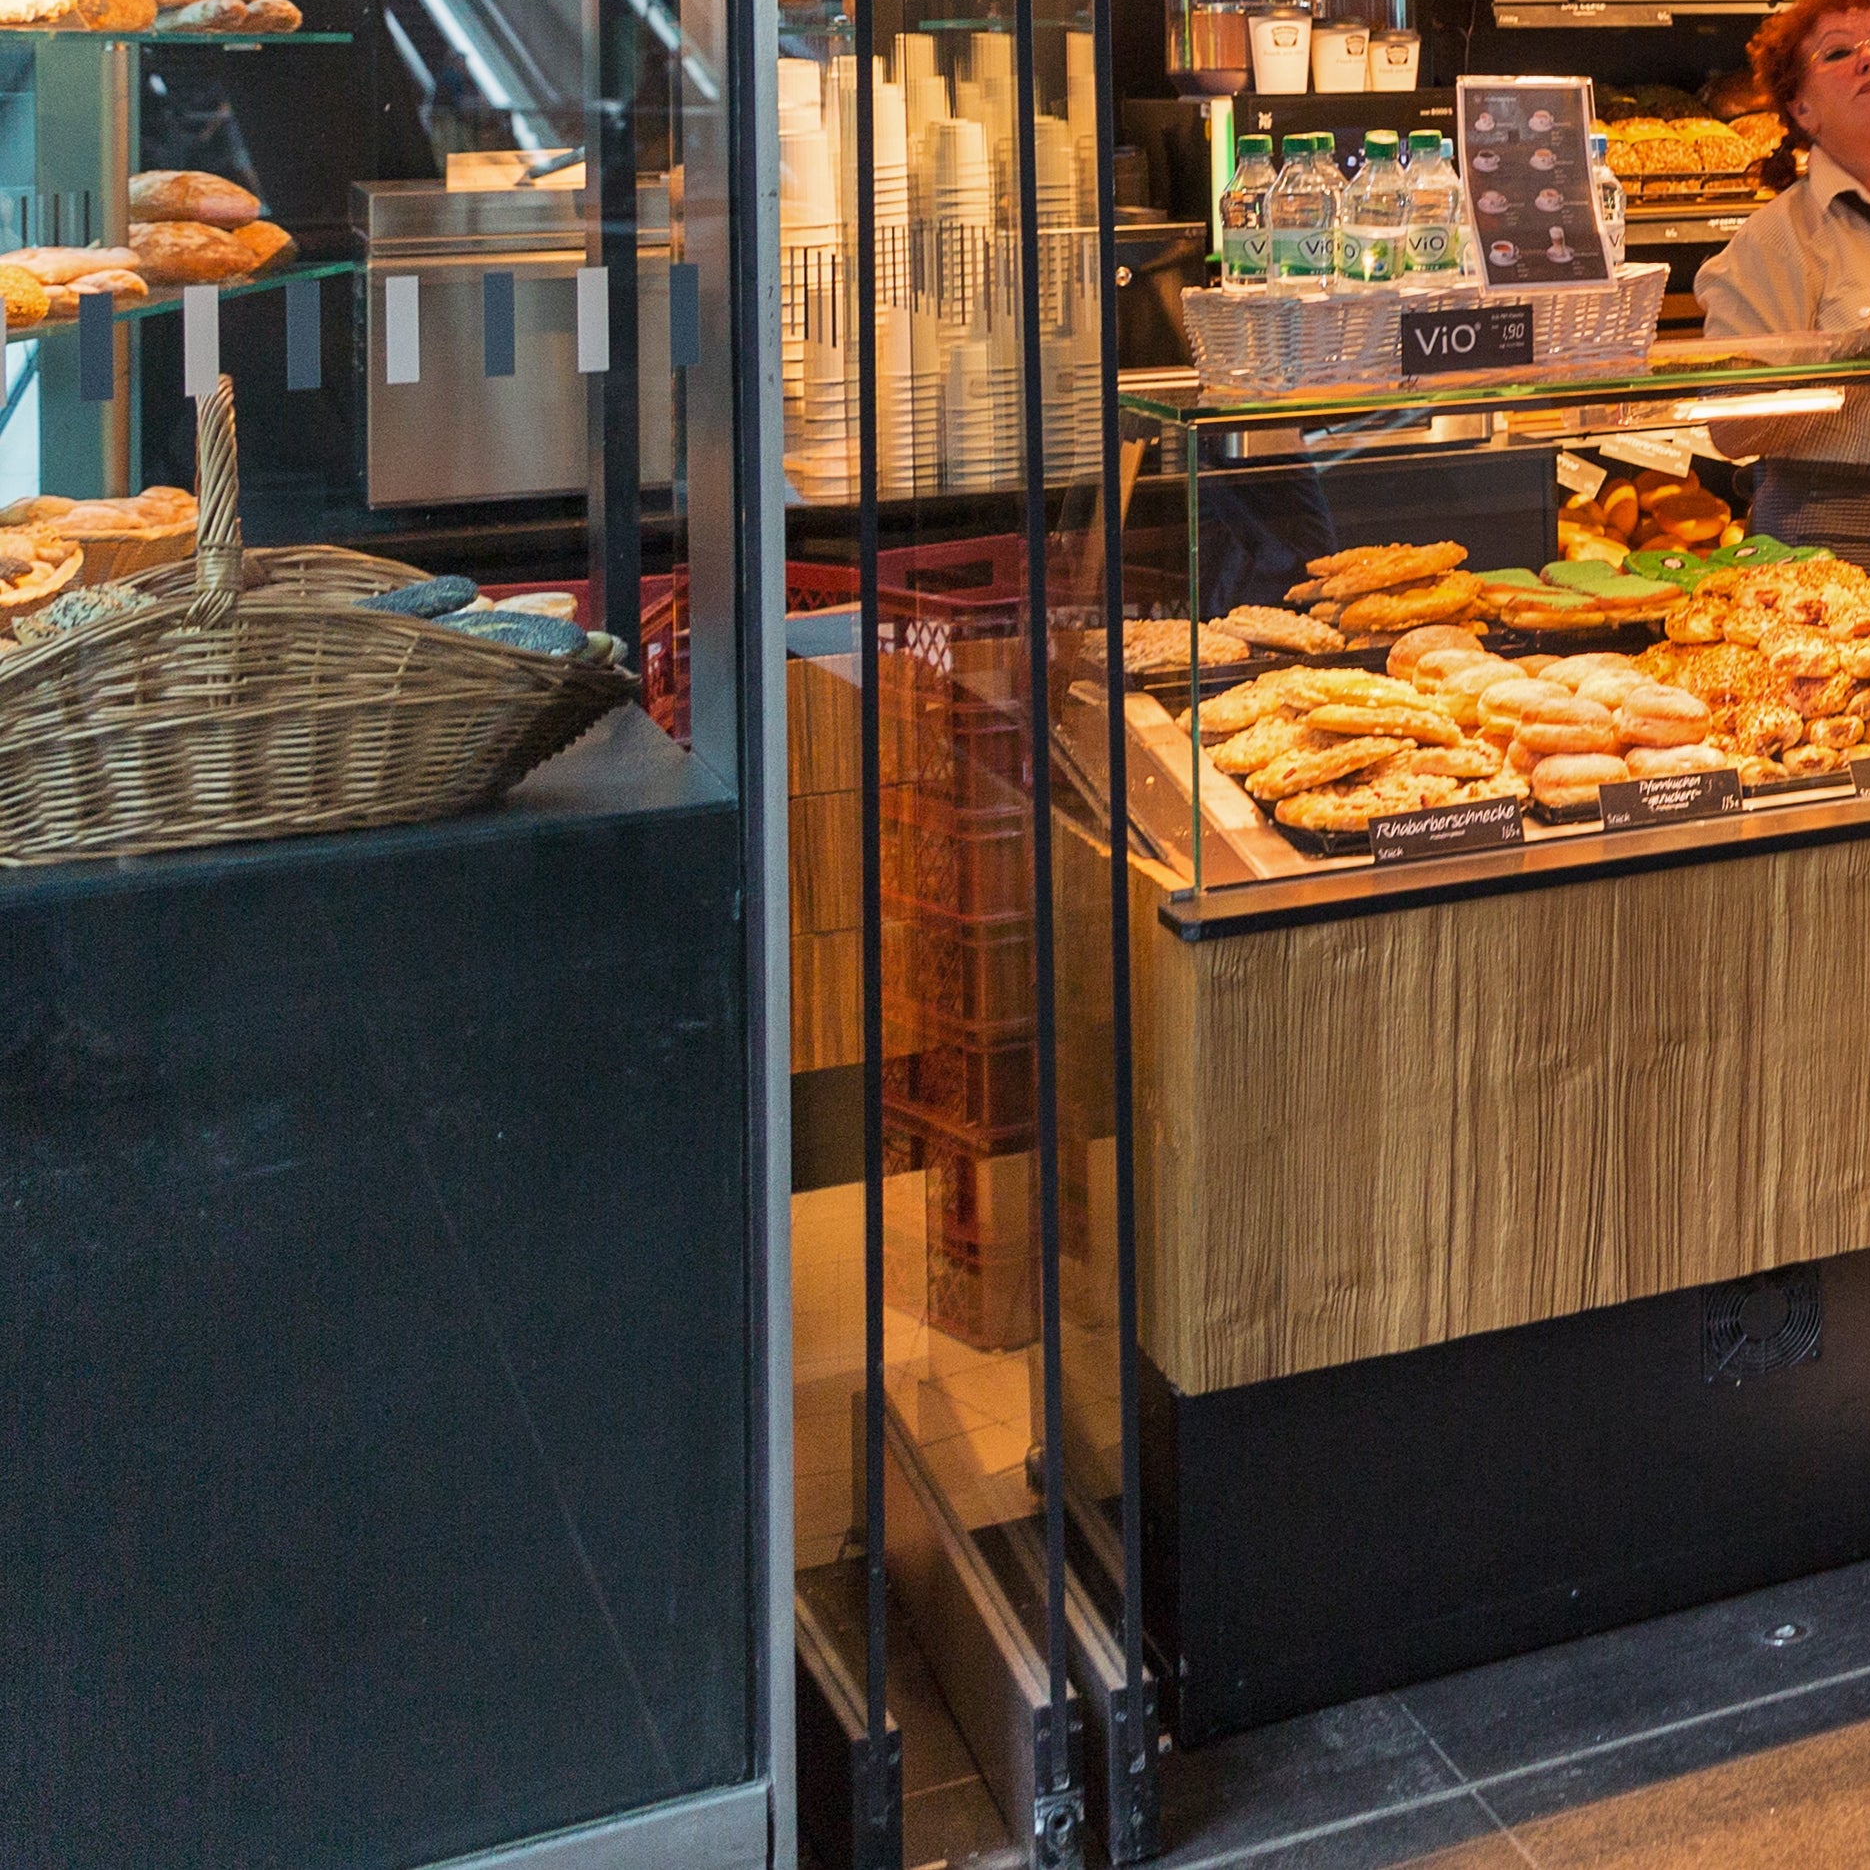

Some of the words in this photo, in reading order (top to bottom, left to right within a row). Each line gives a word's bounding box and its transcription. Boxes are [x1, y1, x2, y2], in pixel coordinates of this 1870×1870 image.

[1408, 234, 1445, 252] ViO
[1502, 322, 1525, 341] 1,90
[1376, 803, 1515, 841] Rhabarberschnecke
